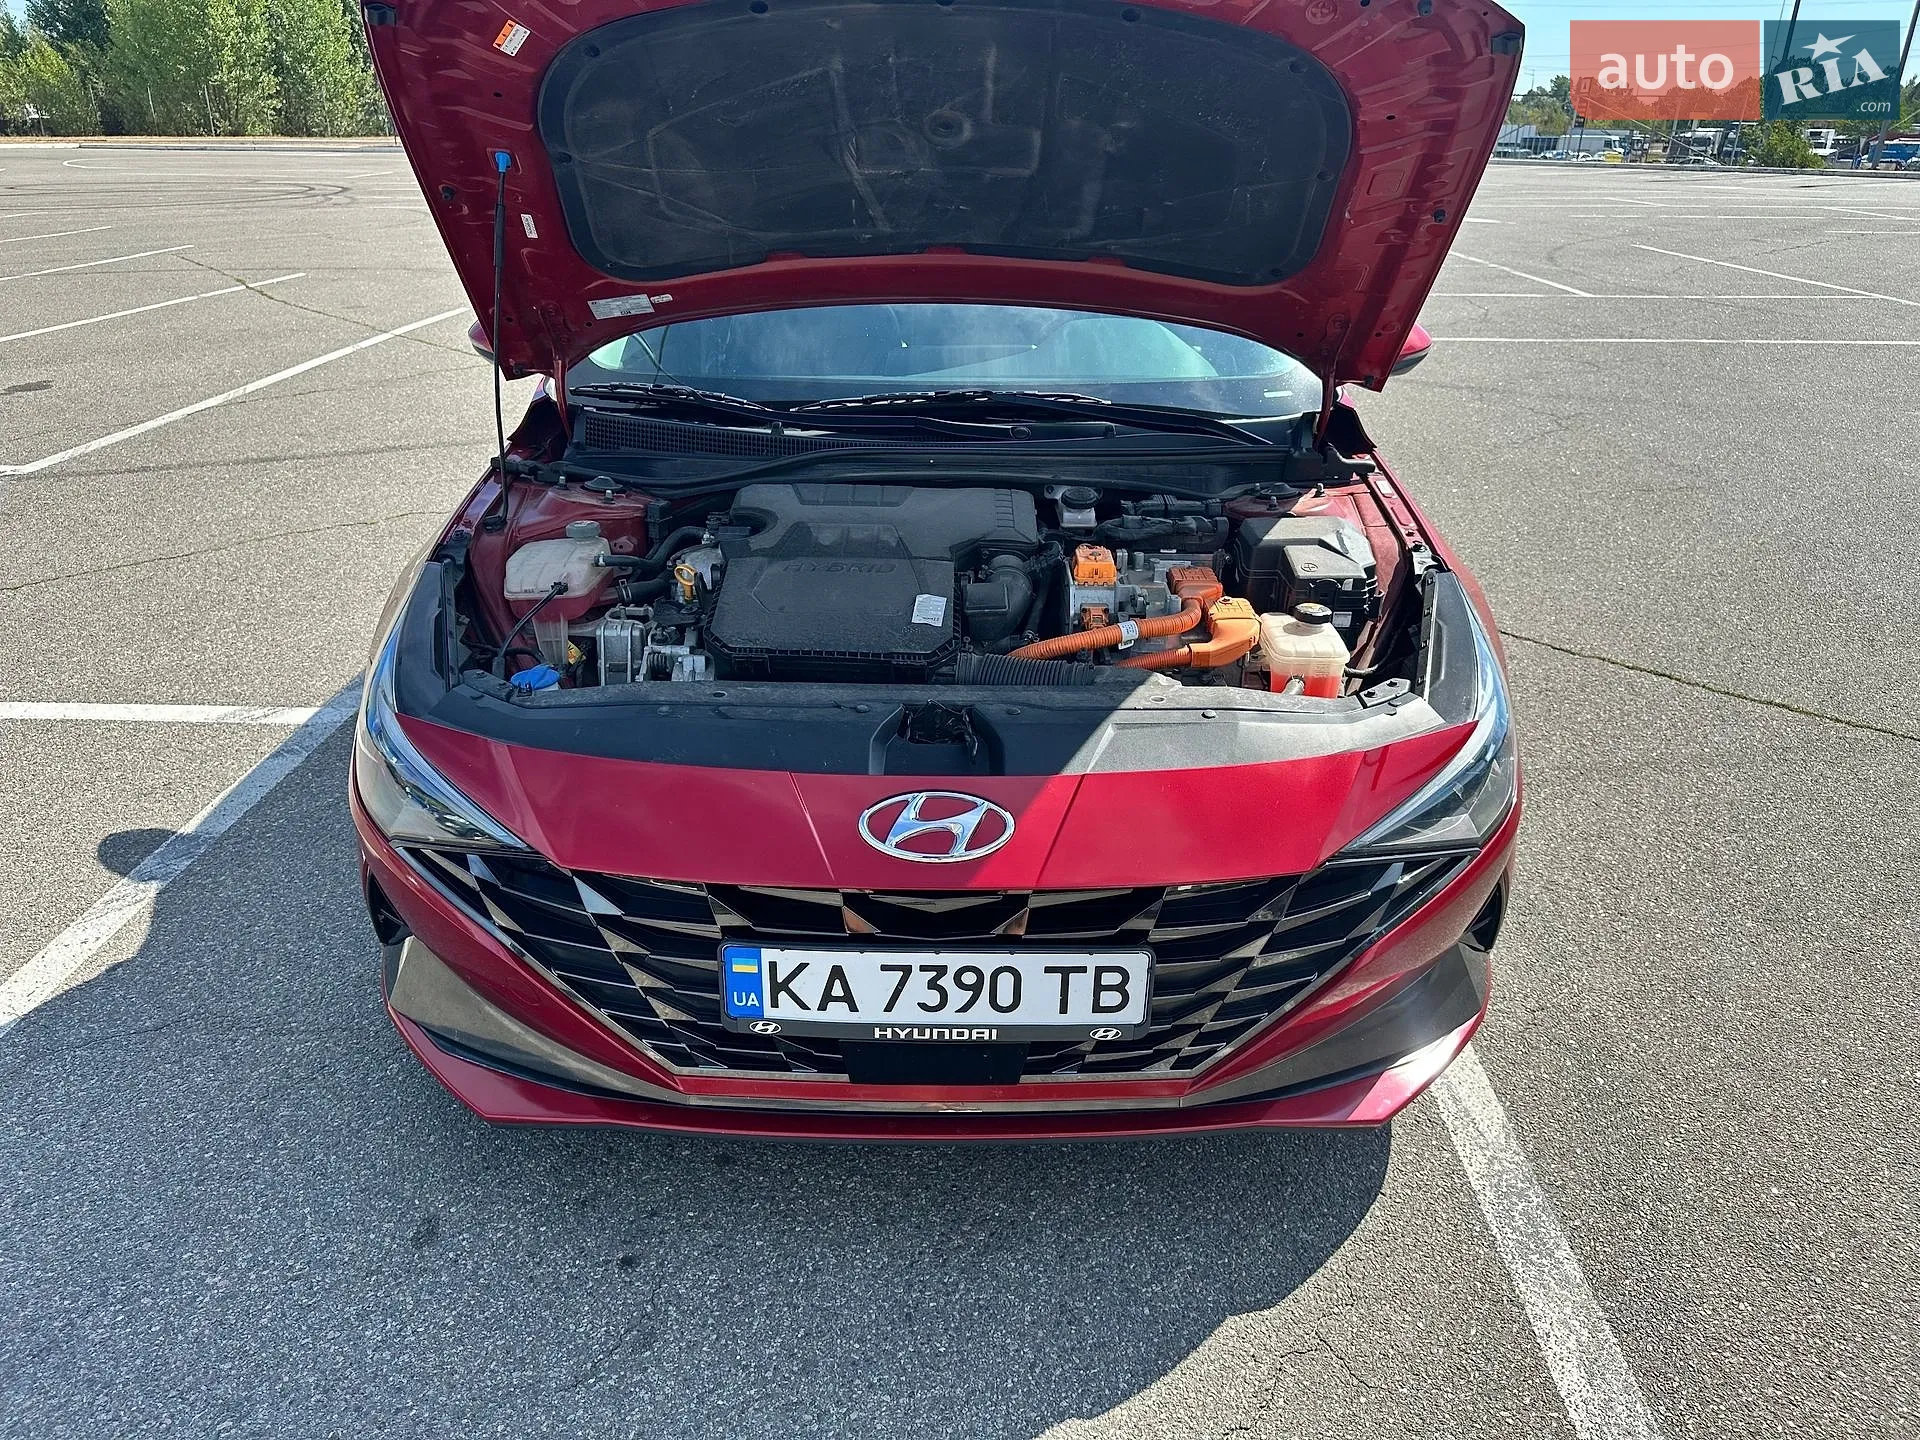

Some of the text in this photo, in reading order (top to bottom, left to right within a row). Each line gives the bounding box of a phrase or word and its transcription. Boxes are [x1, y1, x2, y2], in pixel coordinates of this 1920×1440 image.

[782, 561, 898, 575] HYBRID
[768, 962, 1130, 1014] KA 7390 TB
[733, 991, 760, 1007] UA
[874, 1027, 998, 1040] HYUNDAI
